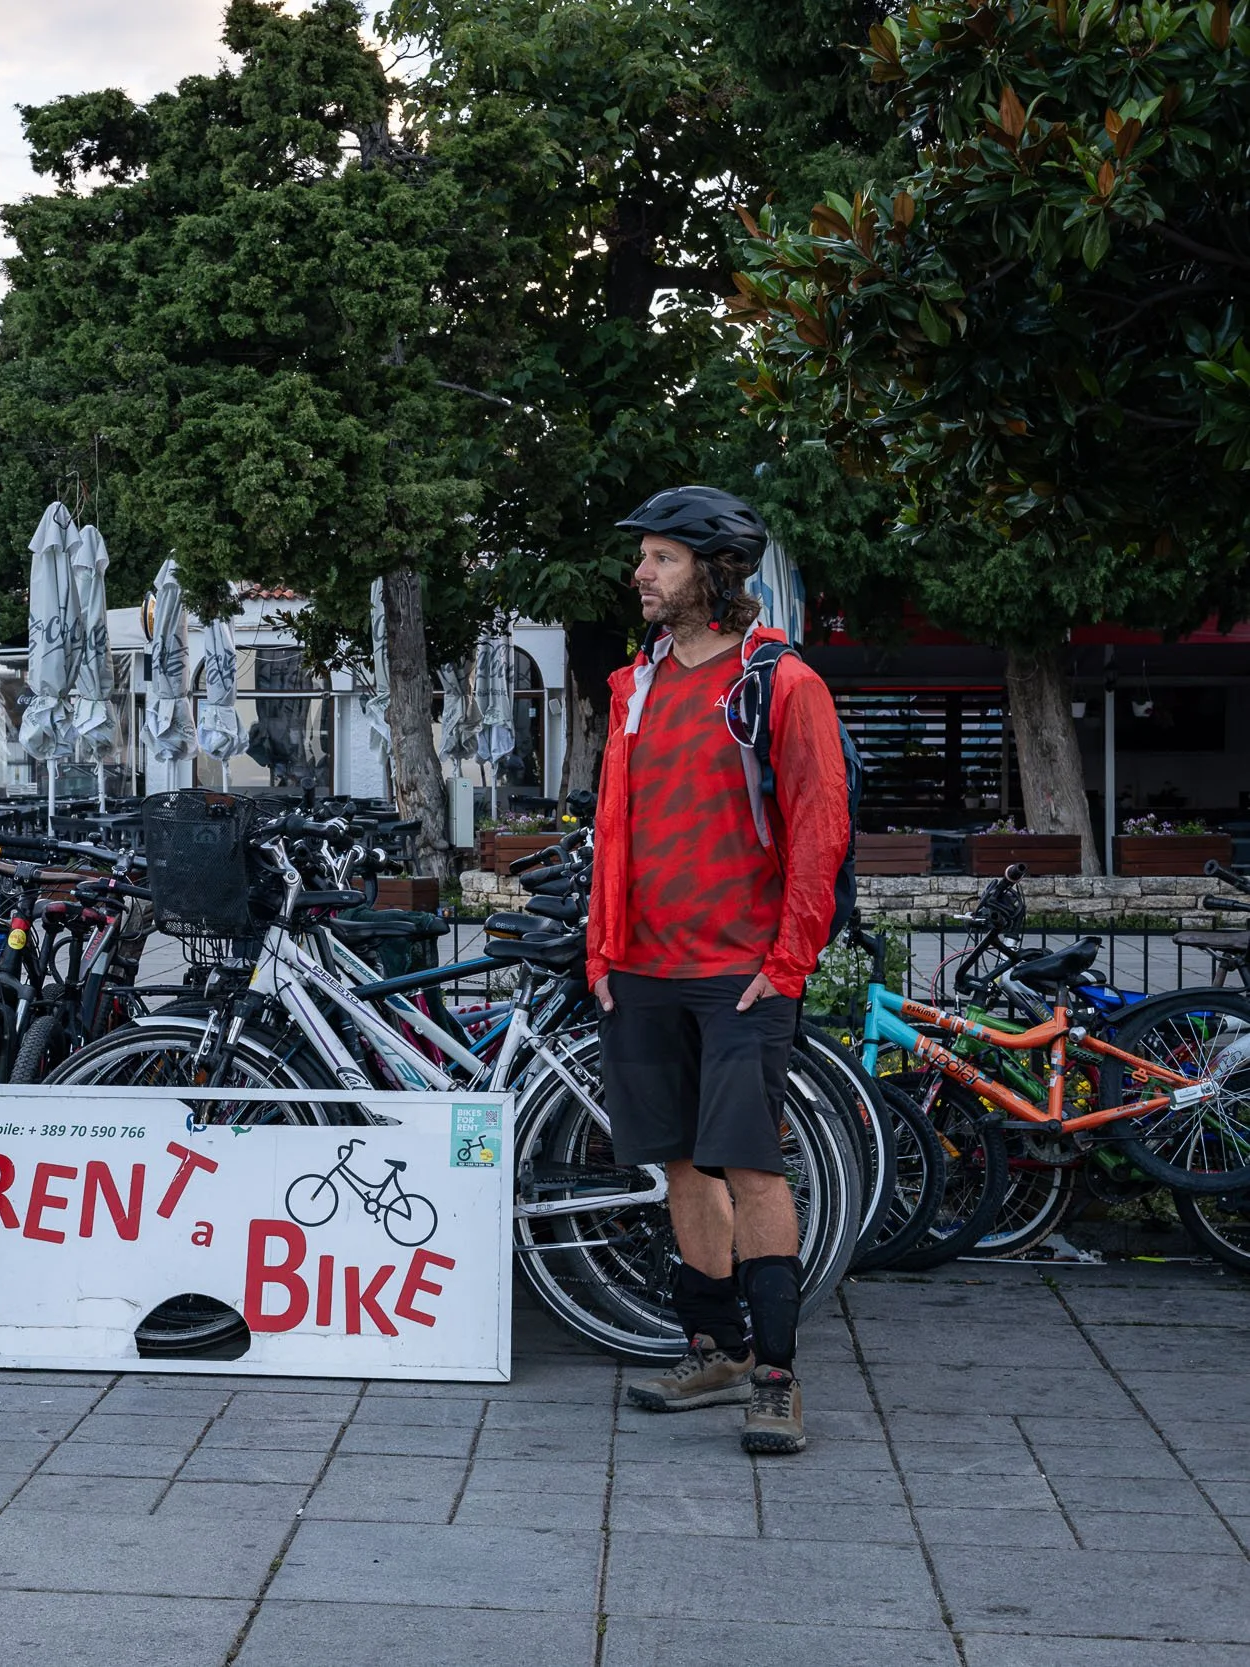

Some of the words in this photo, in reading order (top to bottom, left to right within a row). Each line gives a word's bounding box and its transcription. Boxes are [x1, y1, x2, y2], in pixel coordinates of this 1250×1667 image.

[311, 964, 360, 1005] PRESTO
[906, 1003, 937, 1018] eskimo
[931, 1052, 987, 1086] polar
[457, 1109, 482, 1117] BIKES
[457, 1116, 475, 1124] FOR
[29, 1126, 37, 1135] +
[40, 1124, 66, 1137] 389
[70, 1125, 87, 1137] 70
[90, 1126, 116, 1138] 590
[120, 1126, 146, 1139] 766
[456, 1124, 479, 1132] RENT
[191, 1219, 214, 1247] a
[244, 1218, 456, 1336] BIKE
